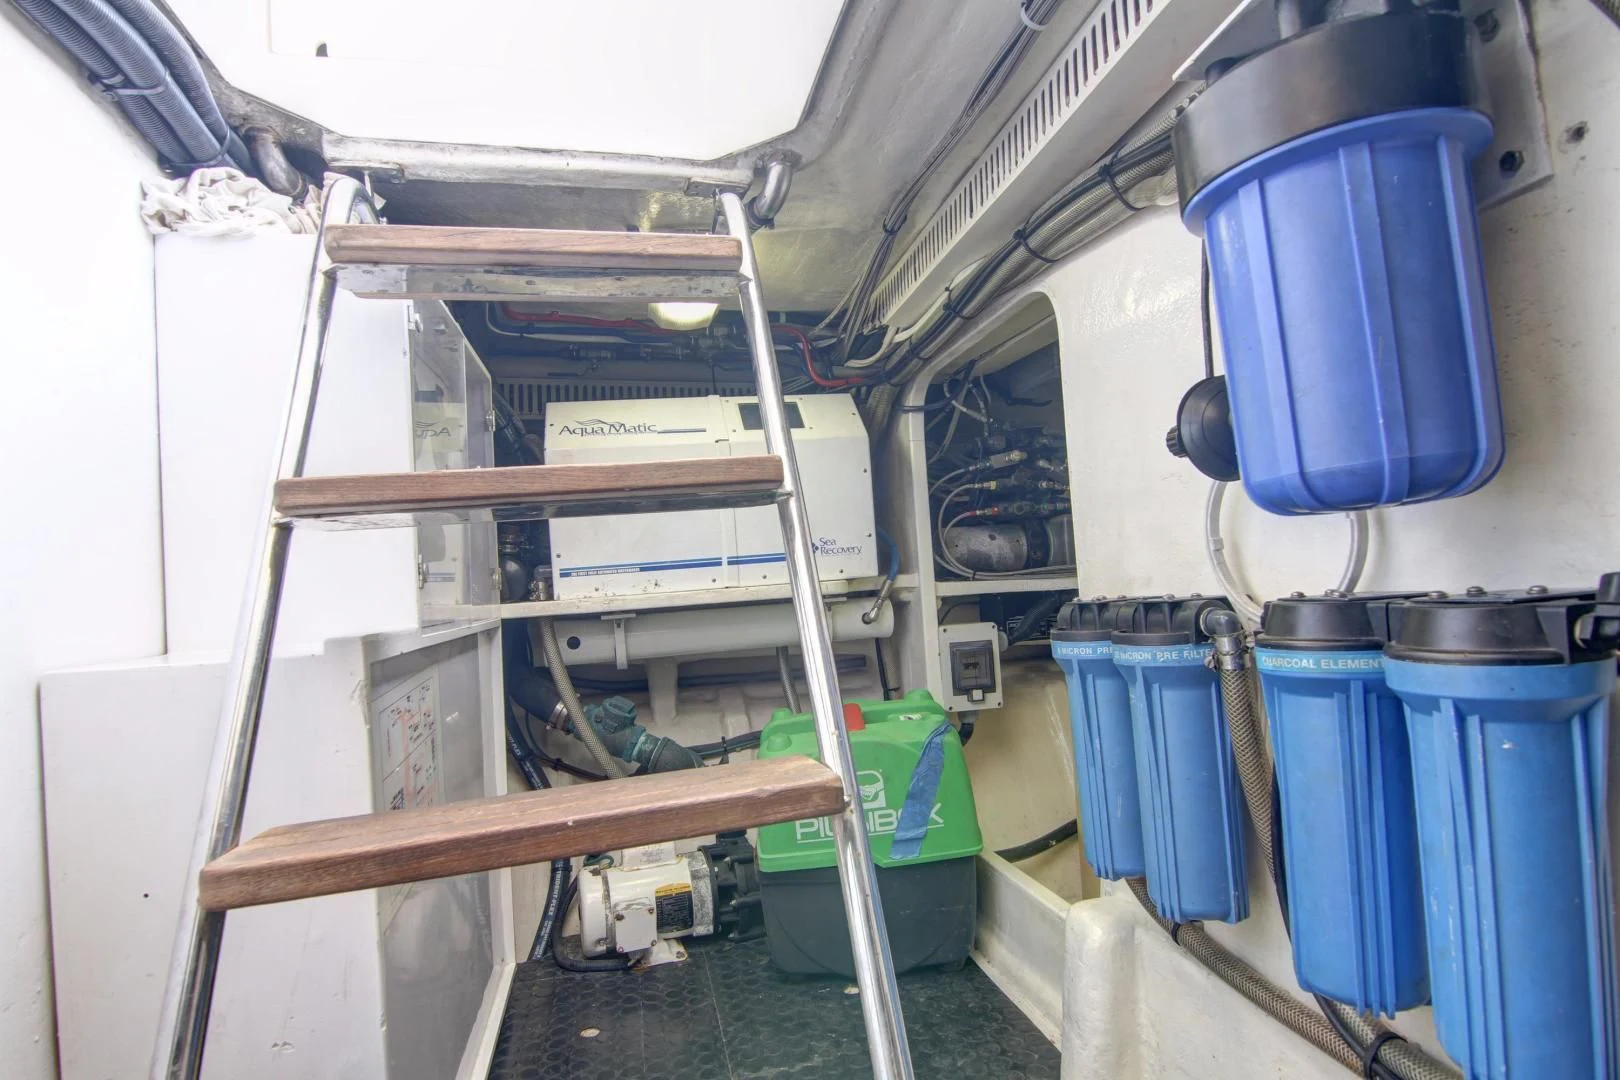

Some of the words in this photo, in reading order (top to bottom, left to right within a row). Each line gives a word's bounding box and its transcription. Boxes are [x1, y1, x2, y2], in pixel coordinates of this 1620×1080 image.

[558, 424, 605, 437] Aqua
[607, 422, 657, 434] Matic
[819, 537, 837, 546] Sea
[820, 546, 863, 555] Recovery
[1157, 649, 1179, 660] PRE
[1183, 648, 1213, 659] FILTE
[1262, 655, 1317, 669] CHARCOAL
